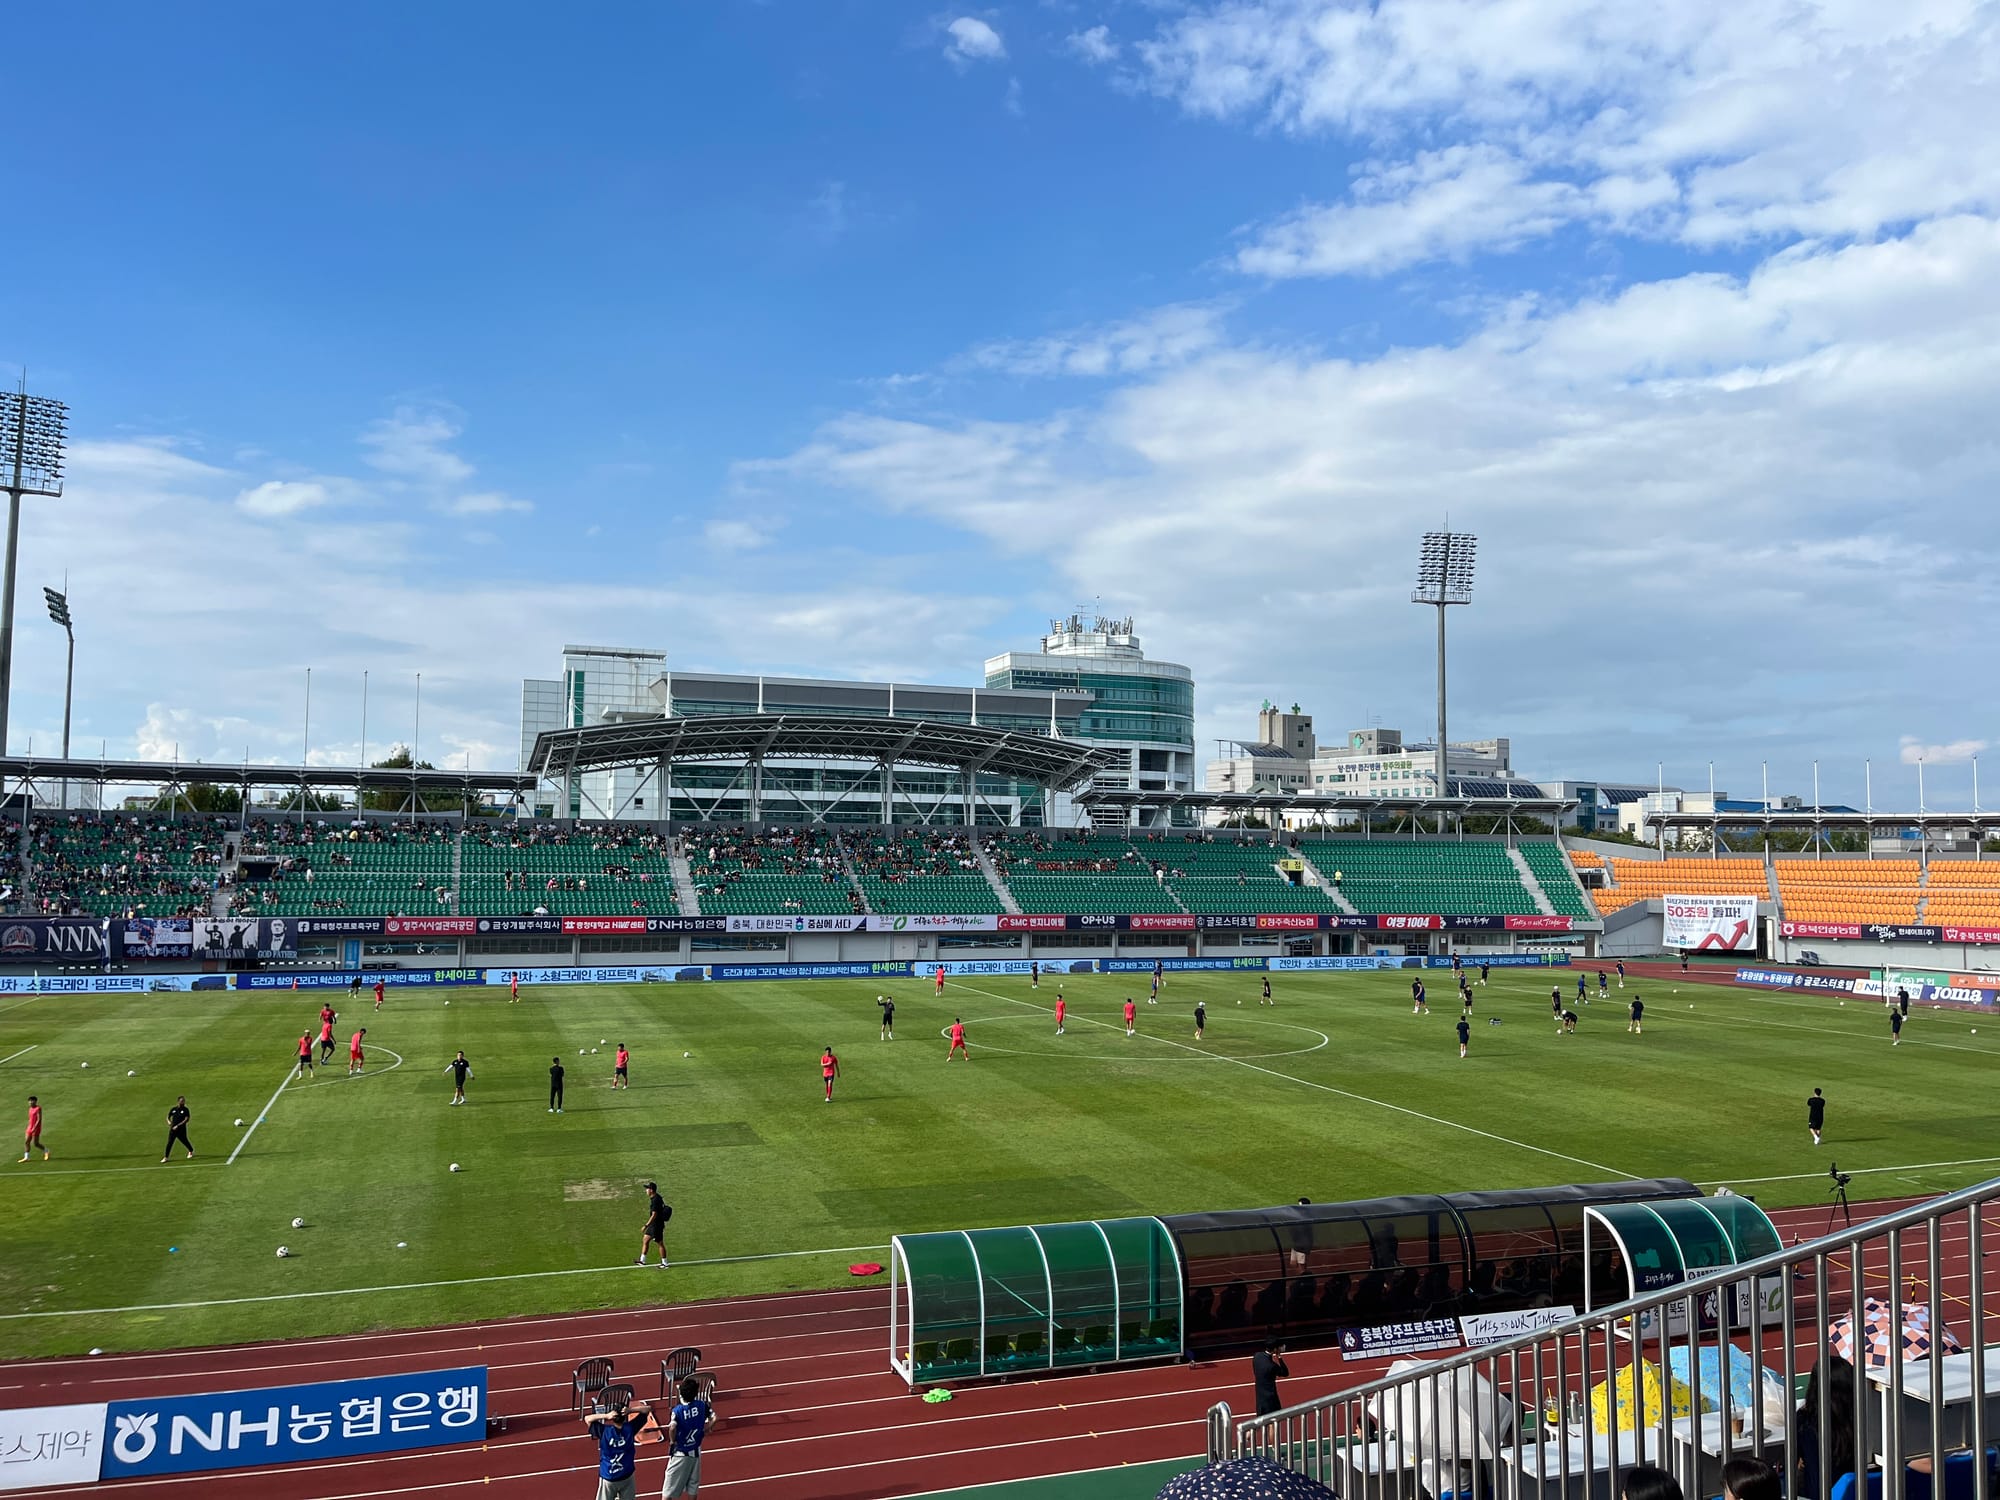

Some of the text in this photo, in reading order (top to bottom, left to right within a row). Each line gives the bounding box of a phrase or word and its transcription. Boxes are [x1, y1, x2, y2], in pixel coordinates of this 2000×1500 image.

[1383, 760, 1412, 770] 청주의료원
[1668, 906, 1740, 918] 50조원 돌파!
[312, 922, 380, 931] 충북청주프로축구단
[402, 920, 474, 930] 청주시시설관리공단
[492, 920, 560, 930] 금성개발주식회사
[576, 921, 610, 930] 충청대학교
[631, 920, 644, 929] 센터
[659, 920, 726, 930] NH농협은행
[732, 920, 851, 930] 충북, 대한민국 중심에 서다
[1010, 918, 1065, 928] SMC 엔지니어링
[1142, 918, 1194, 927] 청주시시설관리공단
[1206, 916, 1256, 927] 글로스터호텔
[1268, 917, 1314, 926] 청주축산농협
[1798, 925, 1859, 934] 충북인삼농협
[1869, 924, 1890, 933] Han
[1898, 928, 1935, 936] 한세이프(주)
[45, 926, 102, 952] NNN
[212, 932, 220, 940] 12
[1879, 930, 1896, 939] Safe
[258, 950, 298, 958] GOD FATHER
[958, 962, 1001, 973] 소형크레인
[1138, 961, 1154, 969] 그리고
[1233, 958, 1262, 968] 한세이프
[1280, 958, 1301, 968] 견인차
[1306, 958, 1342, 968] 소형크레인
[722, 968, 743, 976] 도전과
[744, 968, 756, 976] 창의
[758, 968, 777, 976] 그리고
[778, 967, 797, 976] 혁신의
[798, 966, 811, 974] 정신
[850, 966, 868, 974] 특장차
[872, 962, 906, 973] 한세이프
[250, 977, 275, 986] 도전과
[277, 976, 292, 986] 창의
[320, 976, 343, 984] 혁신의
[408, 974, 430, 982] 특장차
[434, 970, 478, 982] 한세이프
[540, 970, 592, 982] 소형크레인
[1742, 971, 1794, 984] 동원샘물 동원샘물
[26, 979, 88, 992] 소형크레인
[1804, 976, 1854, 991] 글로스터호텔
[1740, 1291, 1767, 1306] 청시
[1654, 1302, 1686, 1317] 충북도
[1468, 1311, 1567, 1336] THIS IS OUR TIME
[1360, 1320, 1456, 1342] 충북청주프로축구단
[1362, 1341, 1390, 1350] CHUNGBUK
[1391, 1338, 1418, 1346] CHEONGJU
[1418, 1335, 1444, 1344] FOOTBALL
[1444, 1332, 1458, 1340] CLUB
[683, 1406, 699, 1420] HB
[170, 1386, 479, 1454] NH농협은행
[0, 1430, 93, 1464] 스제약
